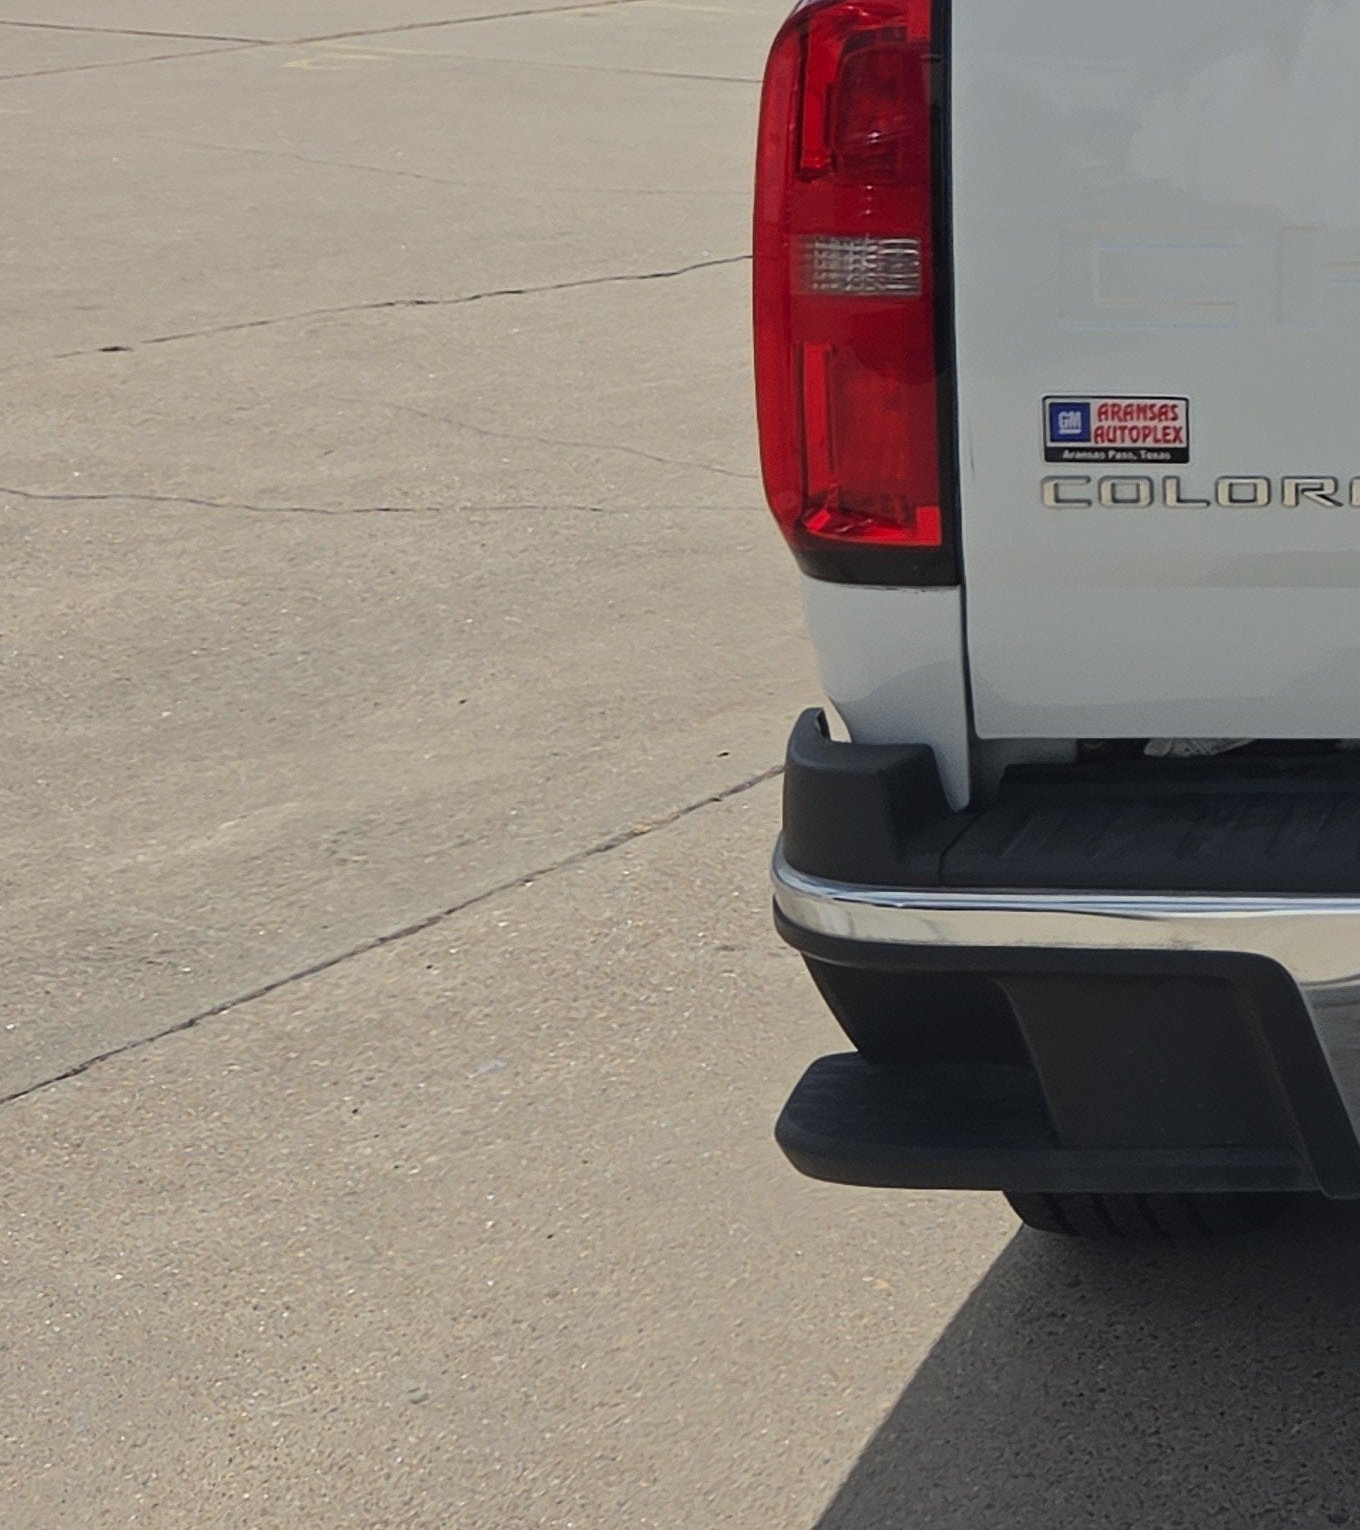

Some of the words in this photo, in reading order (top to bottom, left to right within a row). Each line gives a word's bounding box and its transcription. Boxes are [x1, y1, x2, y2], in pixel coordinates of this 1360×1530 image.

[1059, 411, 1083, 431] GM
[1097, 402, 1179, 423] ARANSAS
[1094, 425, 1184, 445] AUTOPLEX
[1062, 449, 1106, 459] Aransas
[1140, 450, 1172, 460] Texas
